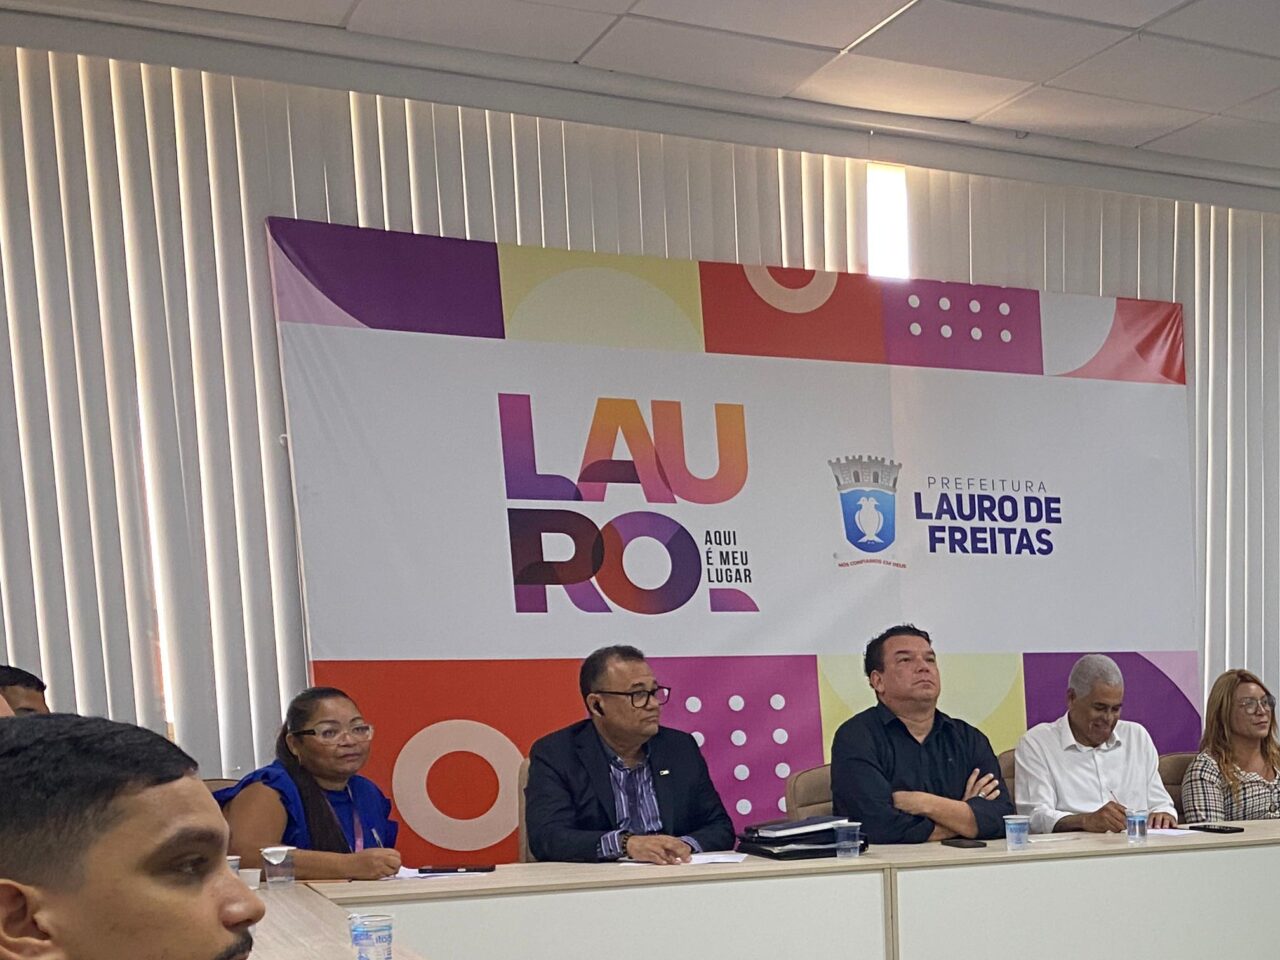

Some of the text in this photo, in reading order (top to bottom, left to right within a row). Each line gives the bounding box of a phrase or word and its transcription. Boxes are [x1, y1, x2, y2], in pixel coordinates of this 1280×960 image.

[498, 393, 748, 504] LAU
[927, 476, 1047, 493] PREFEITURA
[914, 492, 1062, 524] LAURO DE
[704, 530, 737, 546] AQUI
[928, 525, 1054, 555] FREITAS
[706, 547, 748, 566] É MEU
[707, 568, 752, 583] LUGAR
